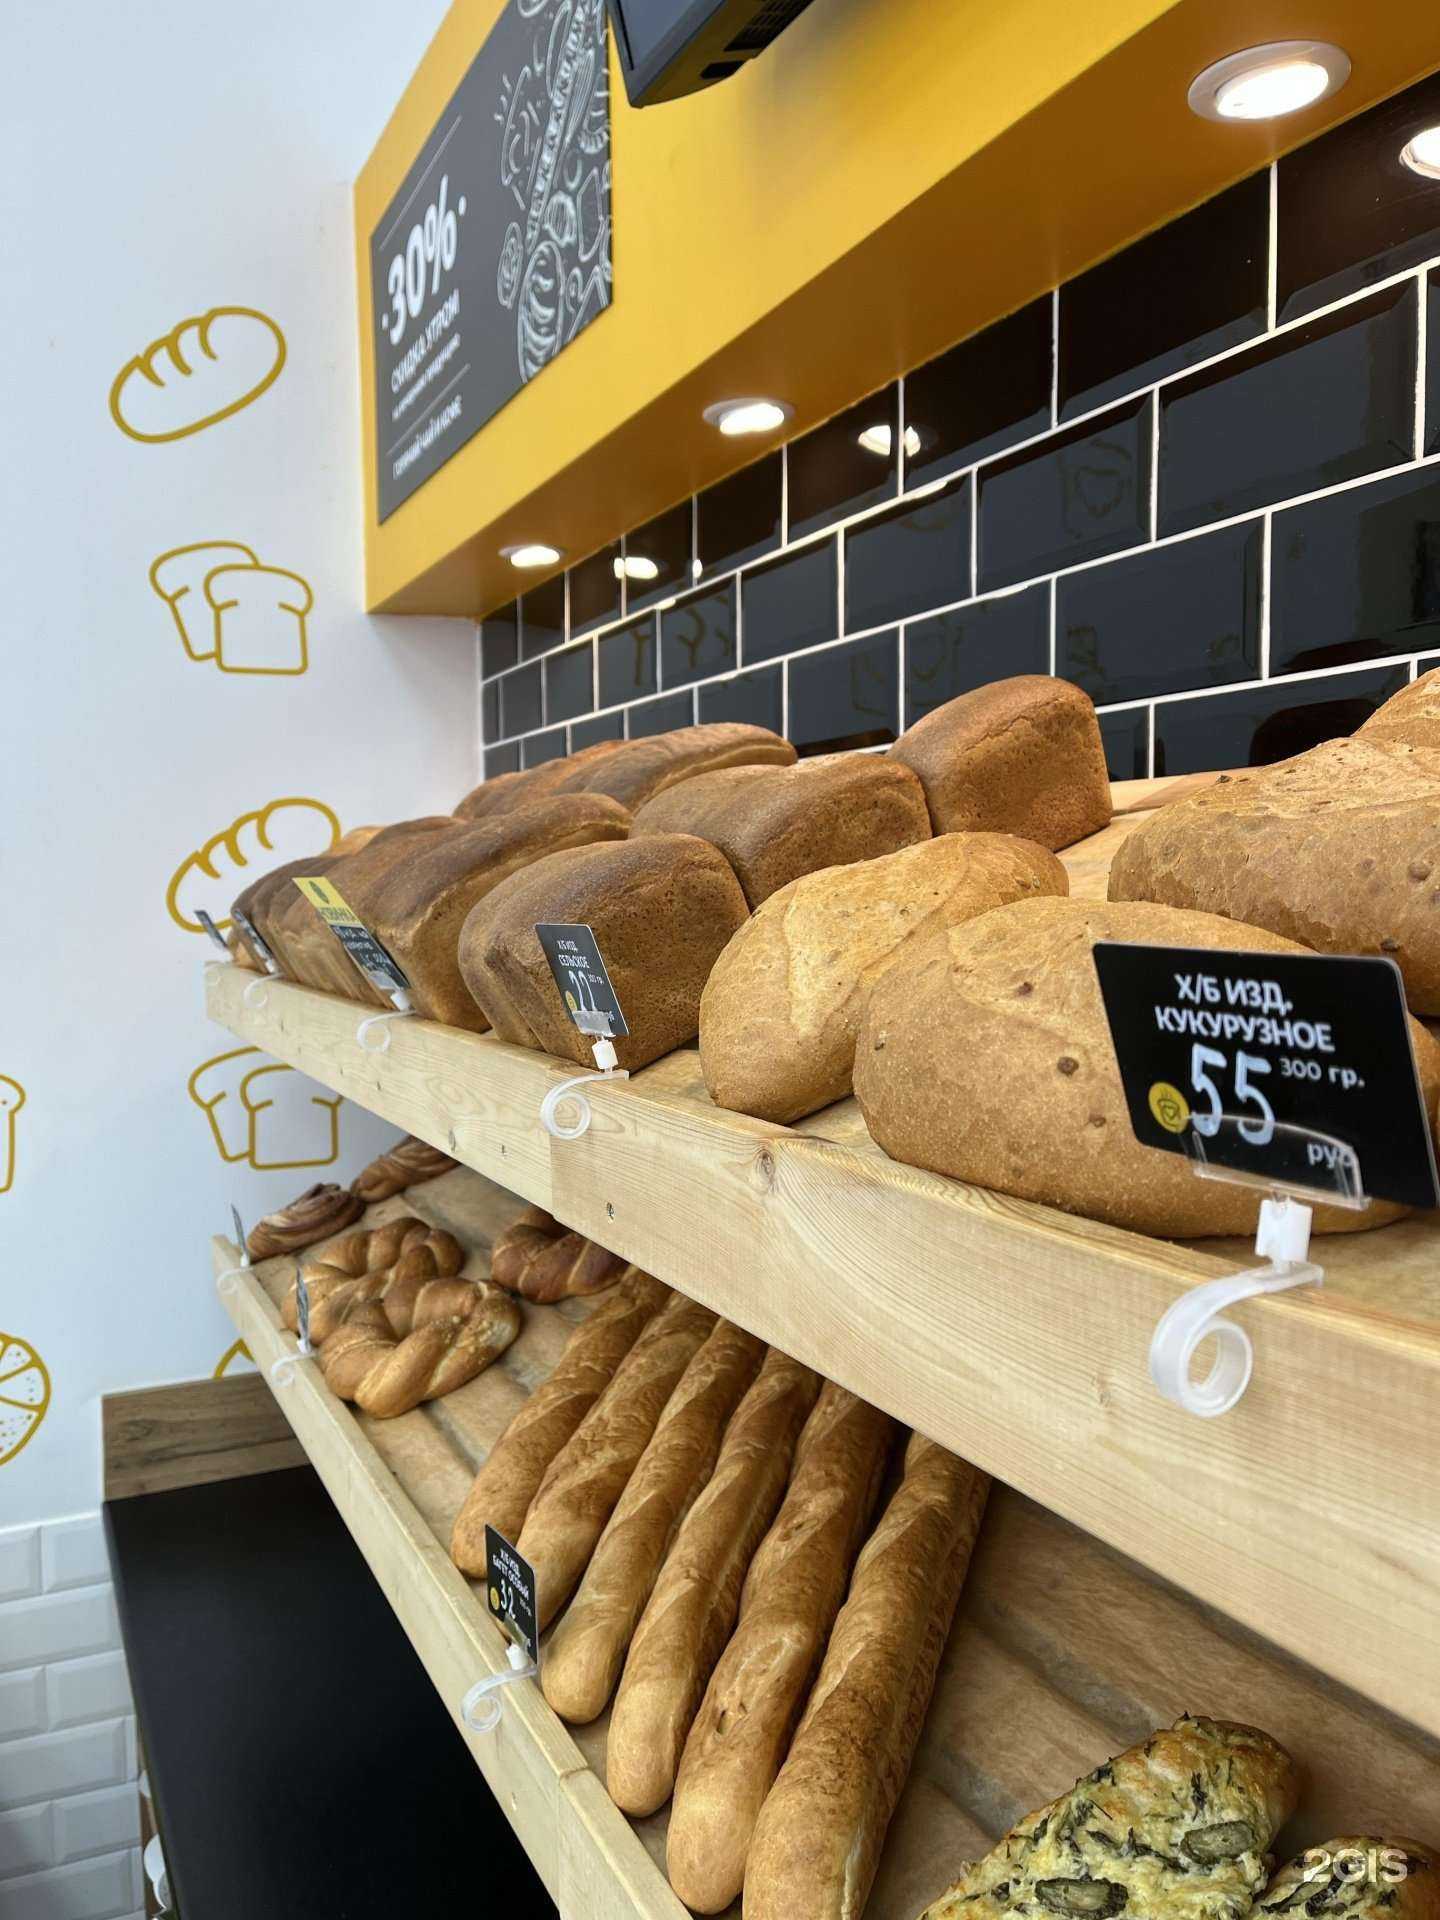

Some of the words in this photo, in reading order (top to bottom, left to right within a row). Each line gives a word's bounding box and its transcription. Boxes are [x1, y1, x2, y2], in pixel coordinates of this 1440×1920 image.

[1174, 973, 1221, 1005] Х/Б
[1224, 978, 1294, 1017] ИЗД.
[1154, 1005, 1336, 1052] КУКУРУЗНОЕ
[1191, 1042, 1276, 1146] 55
[1279, 1057, 1322, 1081] 300
[1328, 1066, 1366, 1090] гр.
